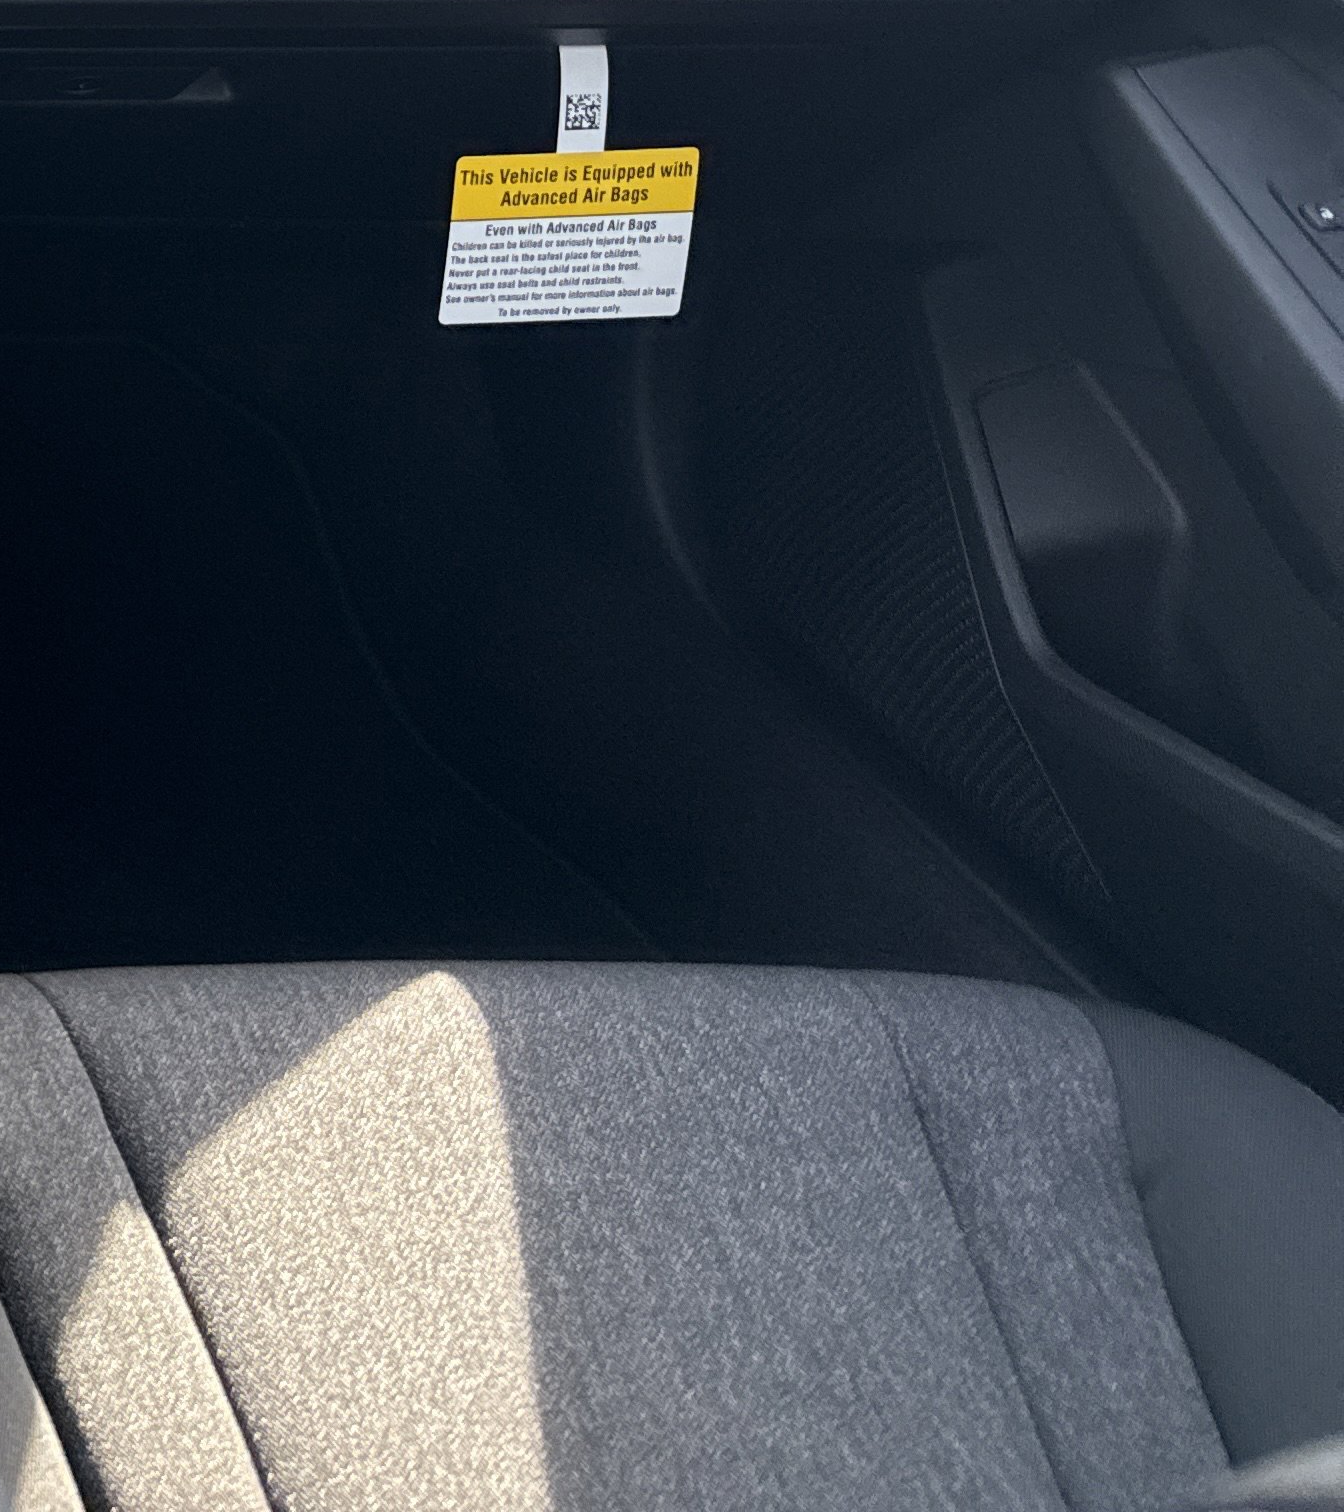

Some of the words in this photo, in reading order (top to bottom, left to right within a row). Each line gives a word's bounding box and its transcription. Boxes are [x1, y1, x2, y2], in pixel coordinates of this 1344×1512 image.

[460, 169, 494, 186] This
[500, 167, 559, 184] Vehicle
[563, 166, 577, 182] is
[582, 162, 656, 184] Equipped
[660, 161, 693, 178] with
[499, 188, 578, 206] Advanced
[582, 187, 606, 203] Air
[610, 186, 649, 205] Bags
[485, 224, 514, 237] Even
[517, 222, 543, 235] with
[546, 219, 604, 235] Advanced
[607, 219, 625, 232] Air
[628, 218, 657, 233] Bags
[451, 242, 488, 252] Children
[489, 242, 505, 250] can
[506, 241, 517, 249] be
[519, 239, 543, 249] killed
[544, 240, 553, 248] or
[555, 237, 593, 248] seriously
[595, 236, 625, 247] injured
[626, 236, 636, 246] by
[638, 234, 652, 244] the
[653, 234, 665, 244] air
[450, 255, 466, 264] The
[468, 255, 489, 264] back
[491, 254, 509, 263] seat
[511, 253, 519, 262] is
[521, 253, 535, 262] the
[537, 252, 563, 261] safest
[564, 251, 588, 262] place
[590, 250, 602, 259] for
[448, 268, 474, 278] Never
[476, 268, 490, 279] put
[500, 266, 547, 276] rear-facing
[548, 264, 570, 274] child
[572, 264, 590, 273] seat
[592, 263, 600, 272] in
[602, 263, 616, 271] the
[446, 282, 477, 291] Always
[479, 282, 495, 290] use
[497, 280, 516, 289] seat
[517, 279, 538, 289] belts
[540, 278, 557, 287] and
[558, 277, 580, 287] child
[445, 295, 461, 304] See
[463, 294, 496, 303] owner's
[497, 293, 529, 302] manual
[531, 292, 543, 301] for
[544, 291, 566, 300] more
[568, 289, 616, 299] information
[617, 288, 641, 297] about
[642, 287, 654, 296] air
[498, 307, 508, 317] To
[510, 307, 520, 316] be
[522, 306, 560, 315] removed
[561, 306, 572, 316] by
[574, 305, 601, 314] owner
